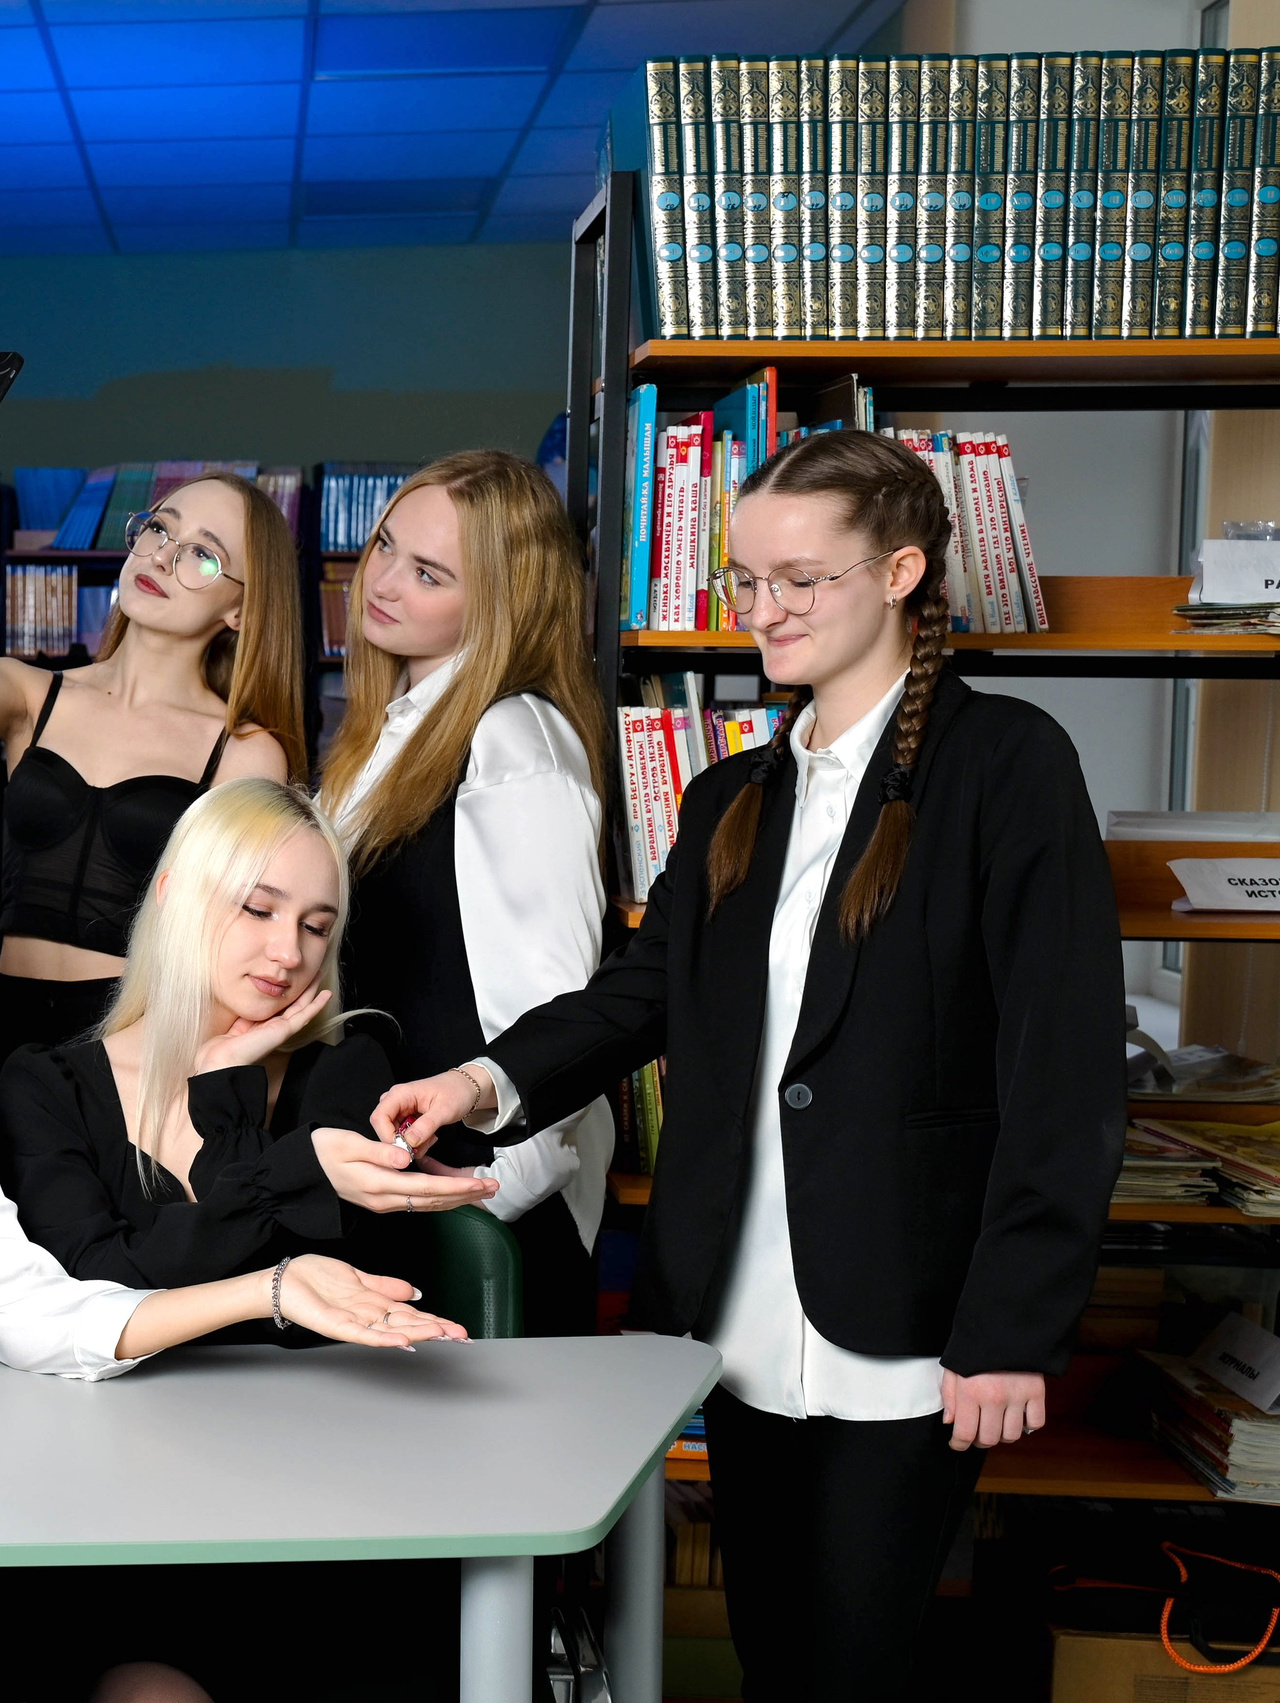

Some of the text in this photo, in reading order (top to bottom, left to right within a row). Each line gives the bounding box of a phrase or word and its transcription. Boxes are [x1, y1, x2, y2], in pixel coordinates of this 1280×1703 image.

[642, 423, 651, 478] МАЛЫШАМ
[967, 460, 976, 485] ДОМА
[690, 482, 698, 512] КАША
[972, 496, 983, 526] ШКОЛЕ
[993, 477, 1008, 534] ИНТЕРЕСНО!
[988, 516, 997, 532] ЭТО
[688, 516, 696, 570] МИШКИНА
[978, 537, 989, 571] МАЛЕЕВ
[990, 534, 1000, 550] ГДЕ
[1004, 535, 1012, 554] ЧТО
[1018, 523, 1031, 559] ЧТЕНИЕ
[674, 560, 682, 600] ХОРОШО
[1007, 556, 1016, 574] ВОТ
[984, 573, 993, 597] ВИТЯ
[1001, 592, 1009, 608] ЭТО
[1025, 561, 1047, 626] ВНЕКЛАССНОЕ
[661, 583, 669, 622] ЖЕНЬКА
[687, 593, 695, 613] Носов
[1003, 610, 1011, 626] ГДЕ
[645, 715, 656, 763] НЕЗНАЙКИ
[636, 740, 649, 790] ЧЕЛОВЕКОМ!
[651, 766, 661, 802] ОСТРОВ
[656, 740, 676, 848] ИКЛЮЧЕНИЯ БУРАТИНО
[644, 792, 652, 814] БУДЬ
[1227, 877, 1280, 886] СКАЗО
[1219, 1351, 1260, 1380] ЖУРНАЛЫ
